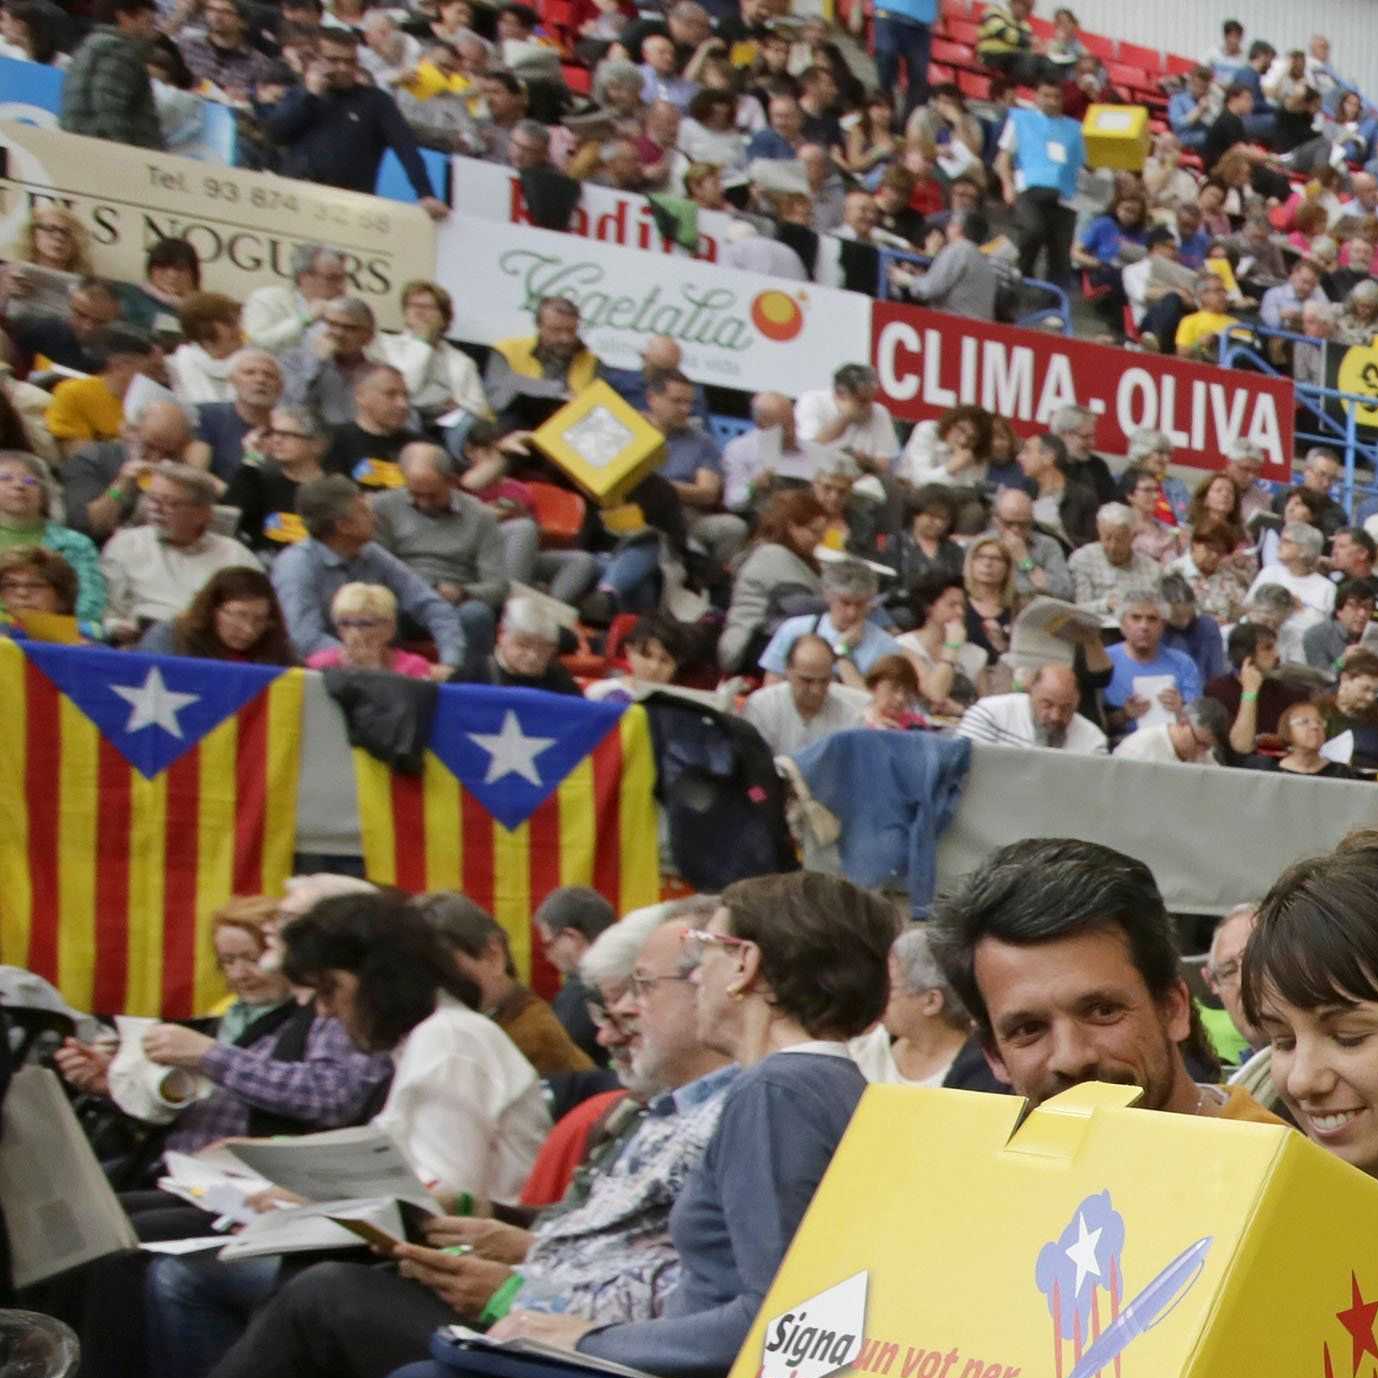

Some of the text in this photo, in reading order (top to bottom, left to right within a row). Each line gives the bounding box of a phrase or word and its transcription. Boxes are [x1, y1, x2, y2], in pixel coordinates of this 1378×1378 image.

[203, 178, 239, 202] 93
[877, 321, 1077, 424] CLIMA
[1116, 368, 1284, 465] OLIVA
[765, 1312, 856, 1368] Signa
[852, 1338, 898, 1376] un
